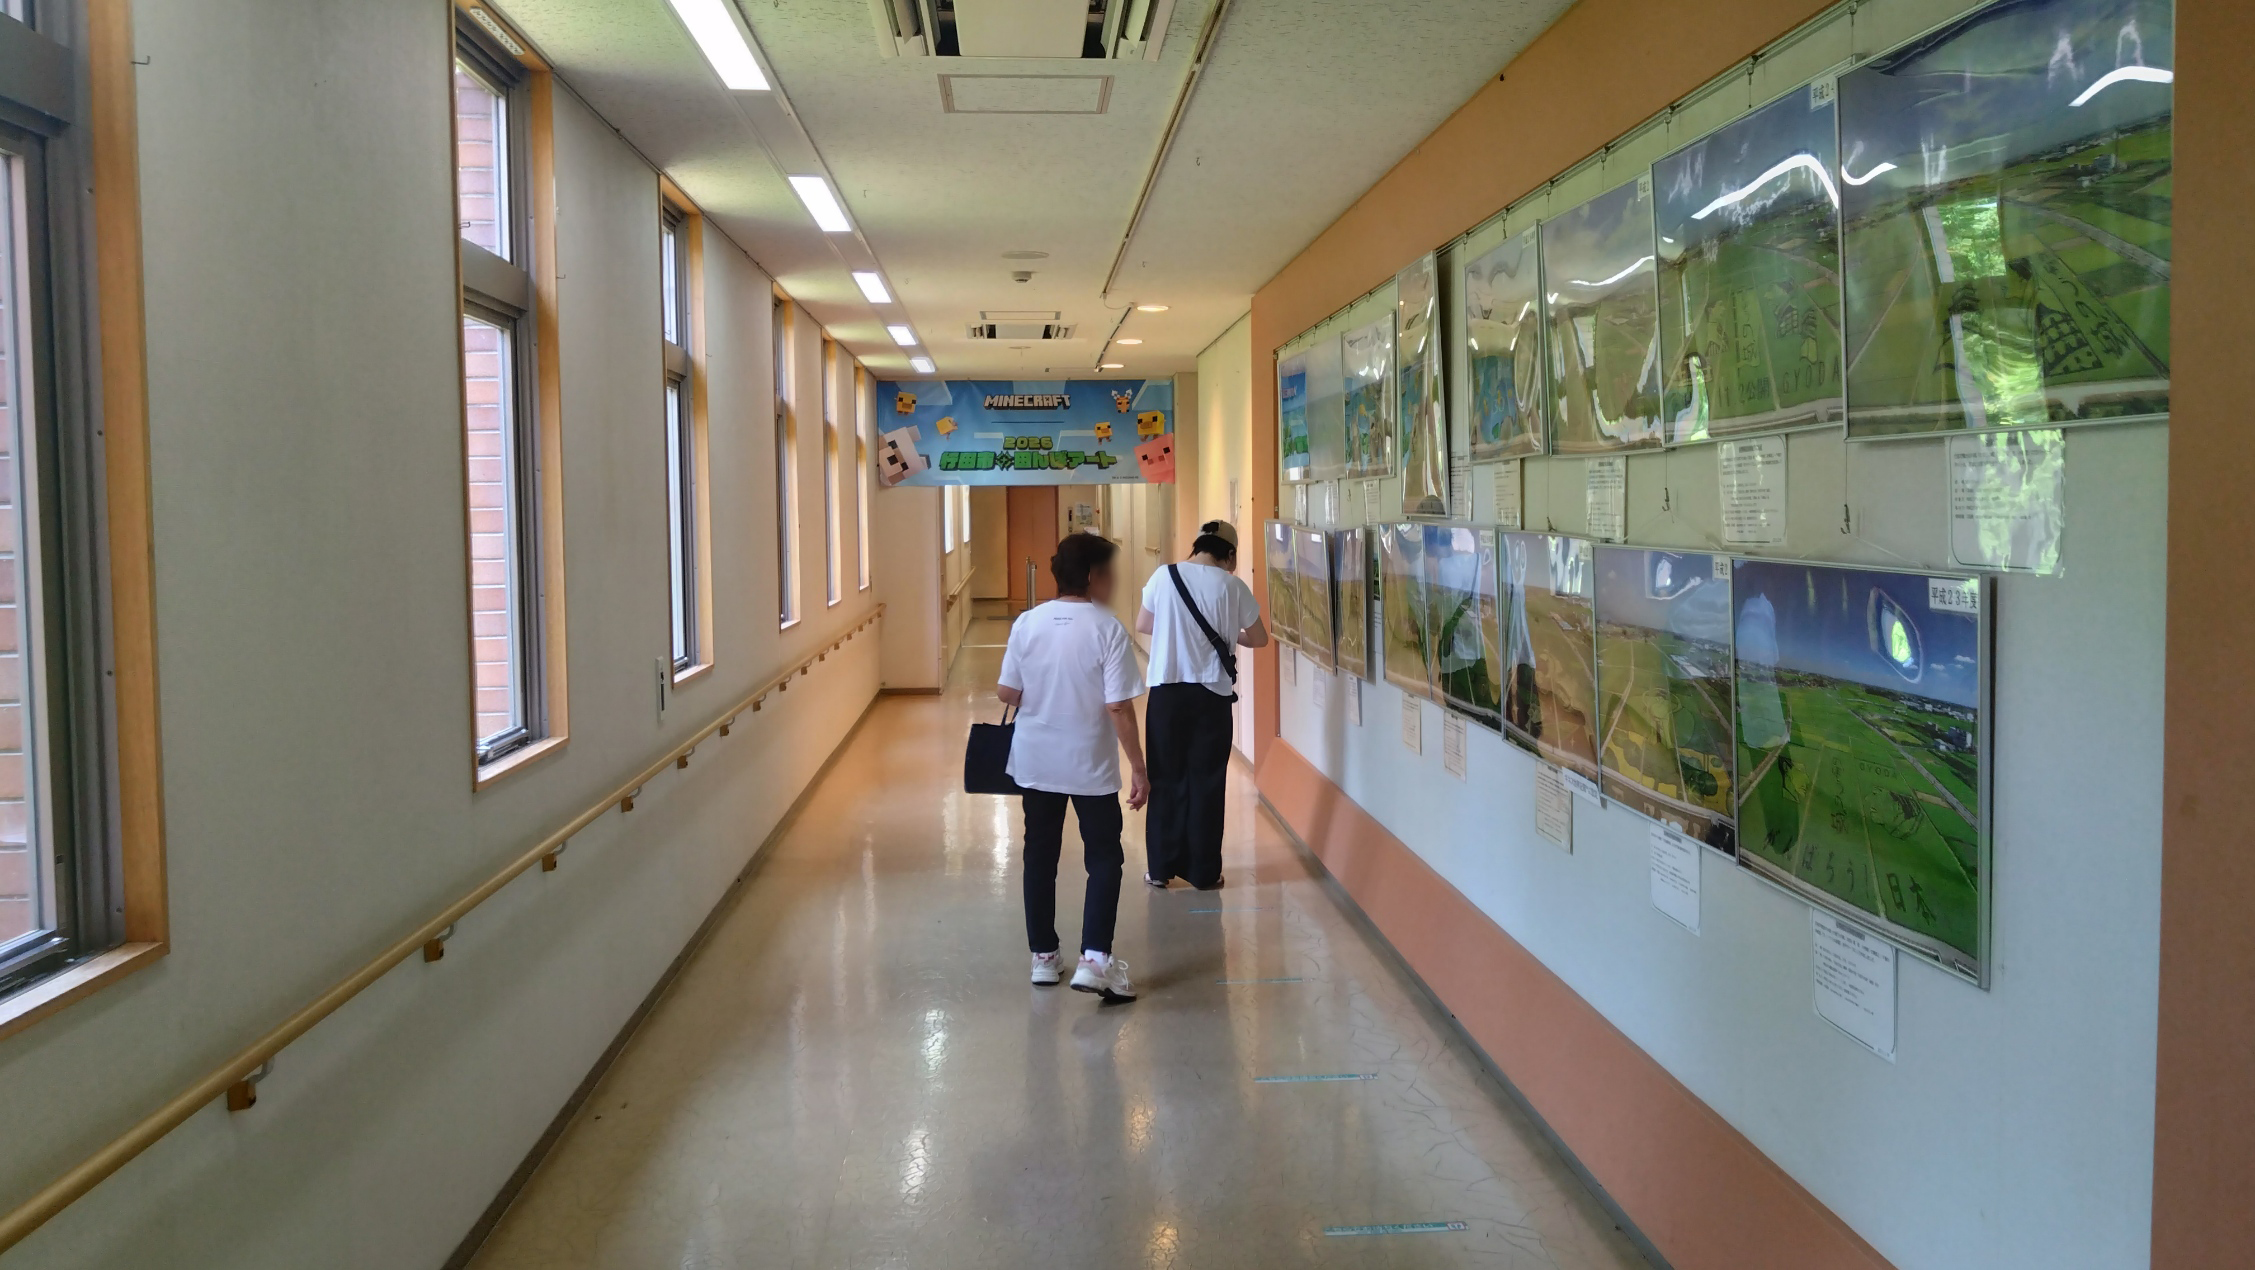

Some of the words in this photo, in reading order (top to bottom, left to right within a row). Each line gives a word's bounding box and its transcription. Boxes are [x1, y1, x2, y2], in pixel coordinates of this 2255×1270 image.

[983, 393, 1071, 410] MINECRAFT
[1003, 436, 1054, 451] 2026
[1931, 586, 1978, 609] 平成23年度
